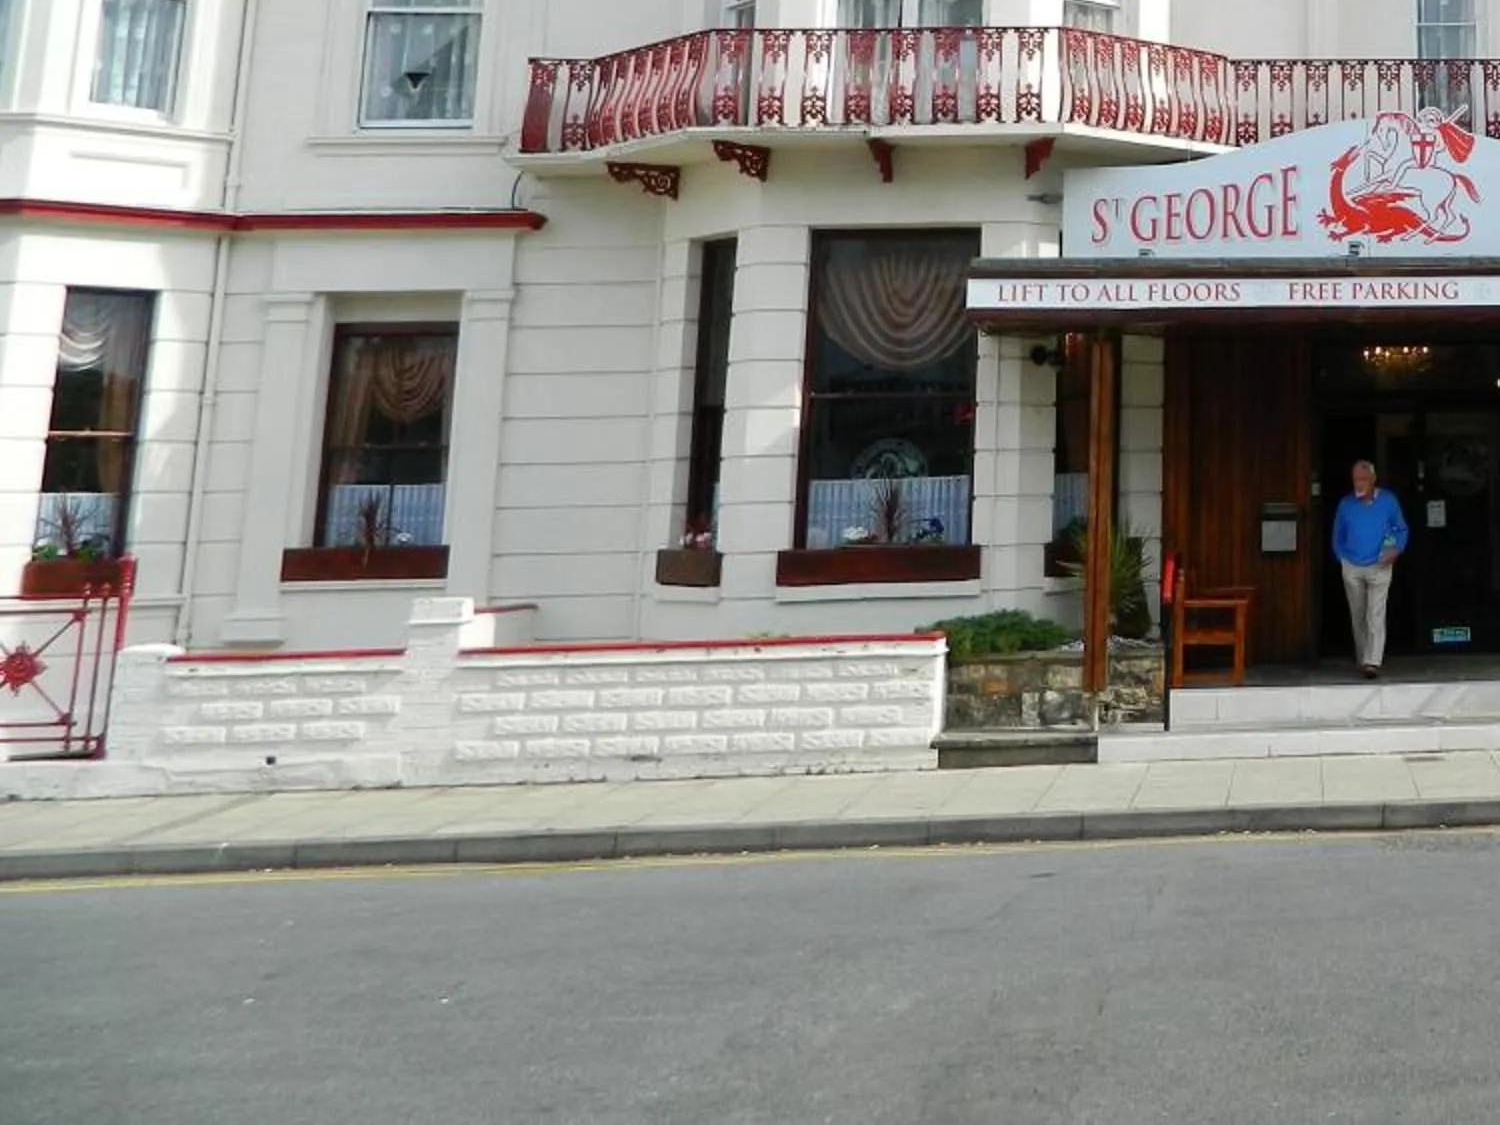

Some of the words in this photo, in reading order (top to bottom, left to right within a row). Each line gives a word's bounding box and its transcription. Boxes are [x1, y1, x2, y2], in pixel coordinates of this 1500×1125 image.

[1130, 165, 1299, 242] GEORGE
[998, 283, 1048, 302] LIFT
[1056, 283, 1089, 302] TO
[1099, 283, 1137, 302] ALL
[1149, 282, 1241, 301] FLOORS
[1288, 282, 1343, 301] FREE
[1352, 281, 1459, 300] PARKING
